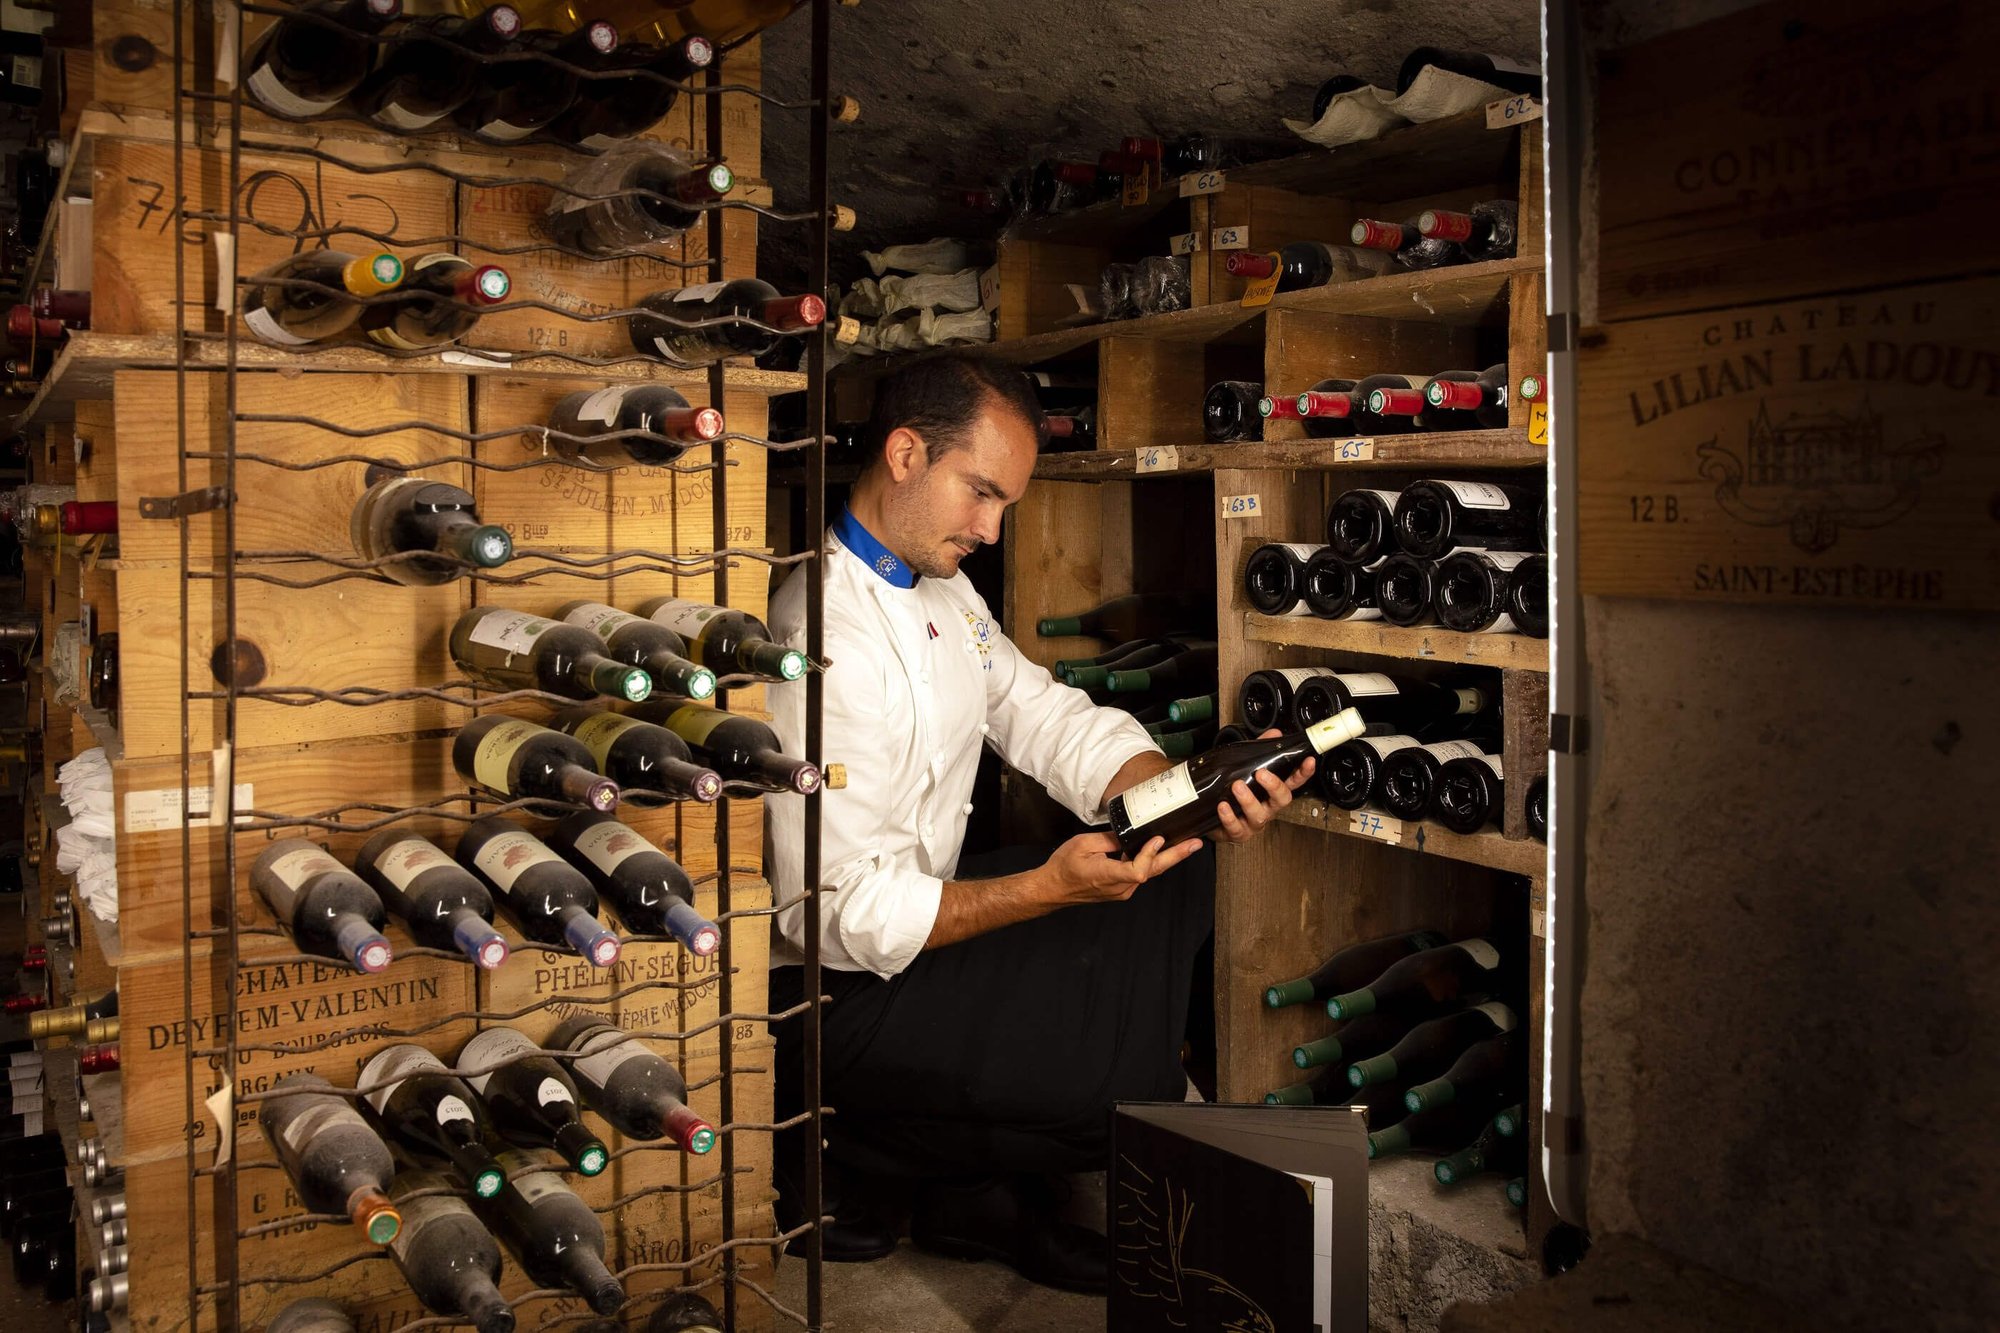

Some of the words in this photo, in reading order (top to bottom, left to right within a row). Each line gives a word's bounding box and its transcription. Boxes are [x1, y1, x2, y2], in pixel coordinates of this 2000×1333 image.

[1505, 97, 1531, 119] 62
[1197, 173, 1220, 190] 62
[1221, 229, 1238, 245] 63
[1703, 301, 1936, 346] CHATEAU
[1629, 349, 1774, 428] LILIAN
[1142, 449, 1159, 467] 66
[1340, 442, 1363, 459] 65
[1231, 497, 1246, 513] 63
[1247, 497, 1257, 511] B
[1629, 495, 1656, 523] 12
[1358, 812, 1384, 833] 77
